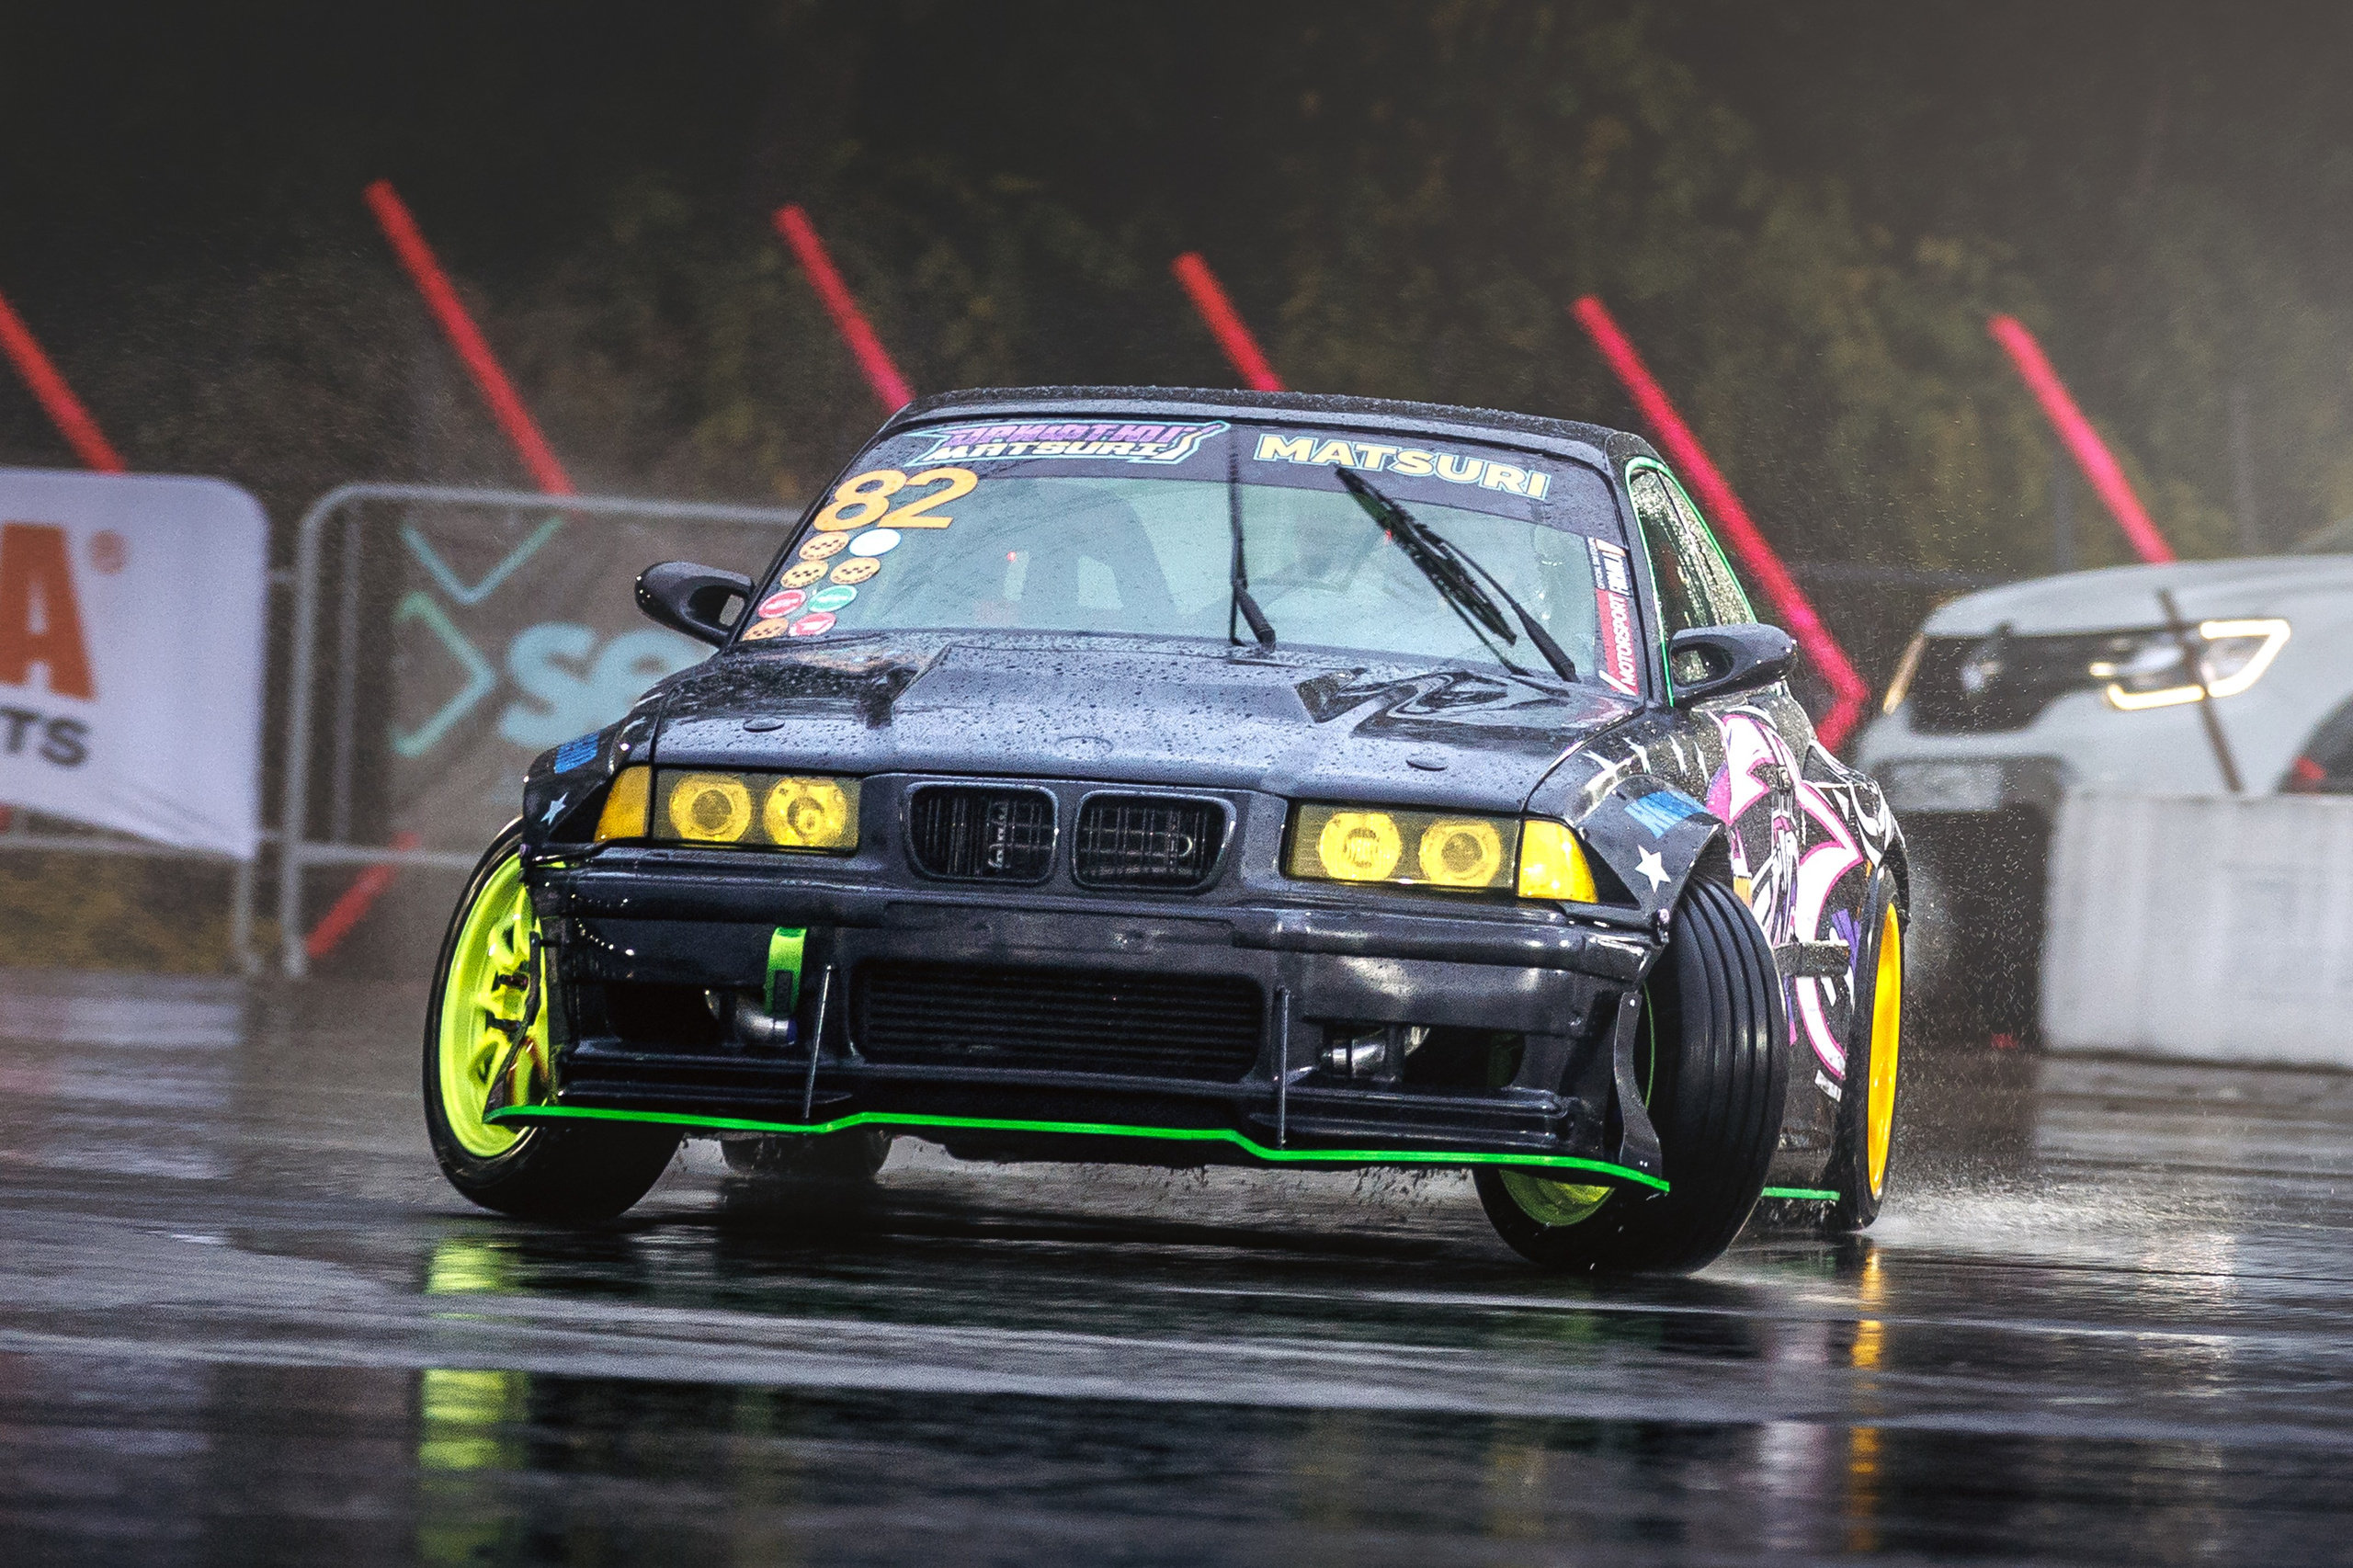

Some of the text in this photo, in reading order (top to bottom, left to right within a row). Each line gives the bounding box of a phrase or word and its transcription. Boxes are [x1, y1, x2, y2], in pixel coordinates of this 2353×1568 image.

[922, 439, 1173, 462] MATSURI
[1256, 434, 1551, 499] MATSURI
[813, 467, 979, 531] 82
[1608, 592, 1638, 687] MOTORSPORT
